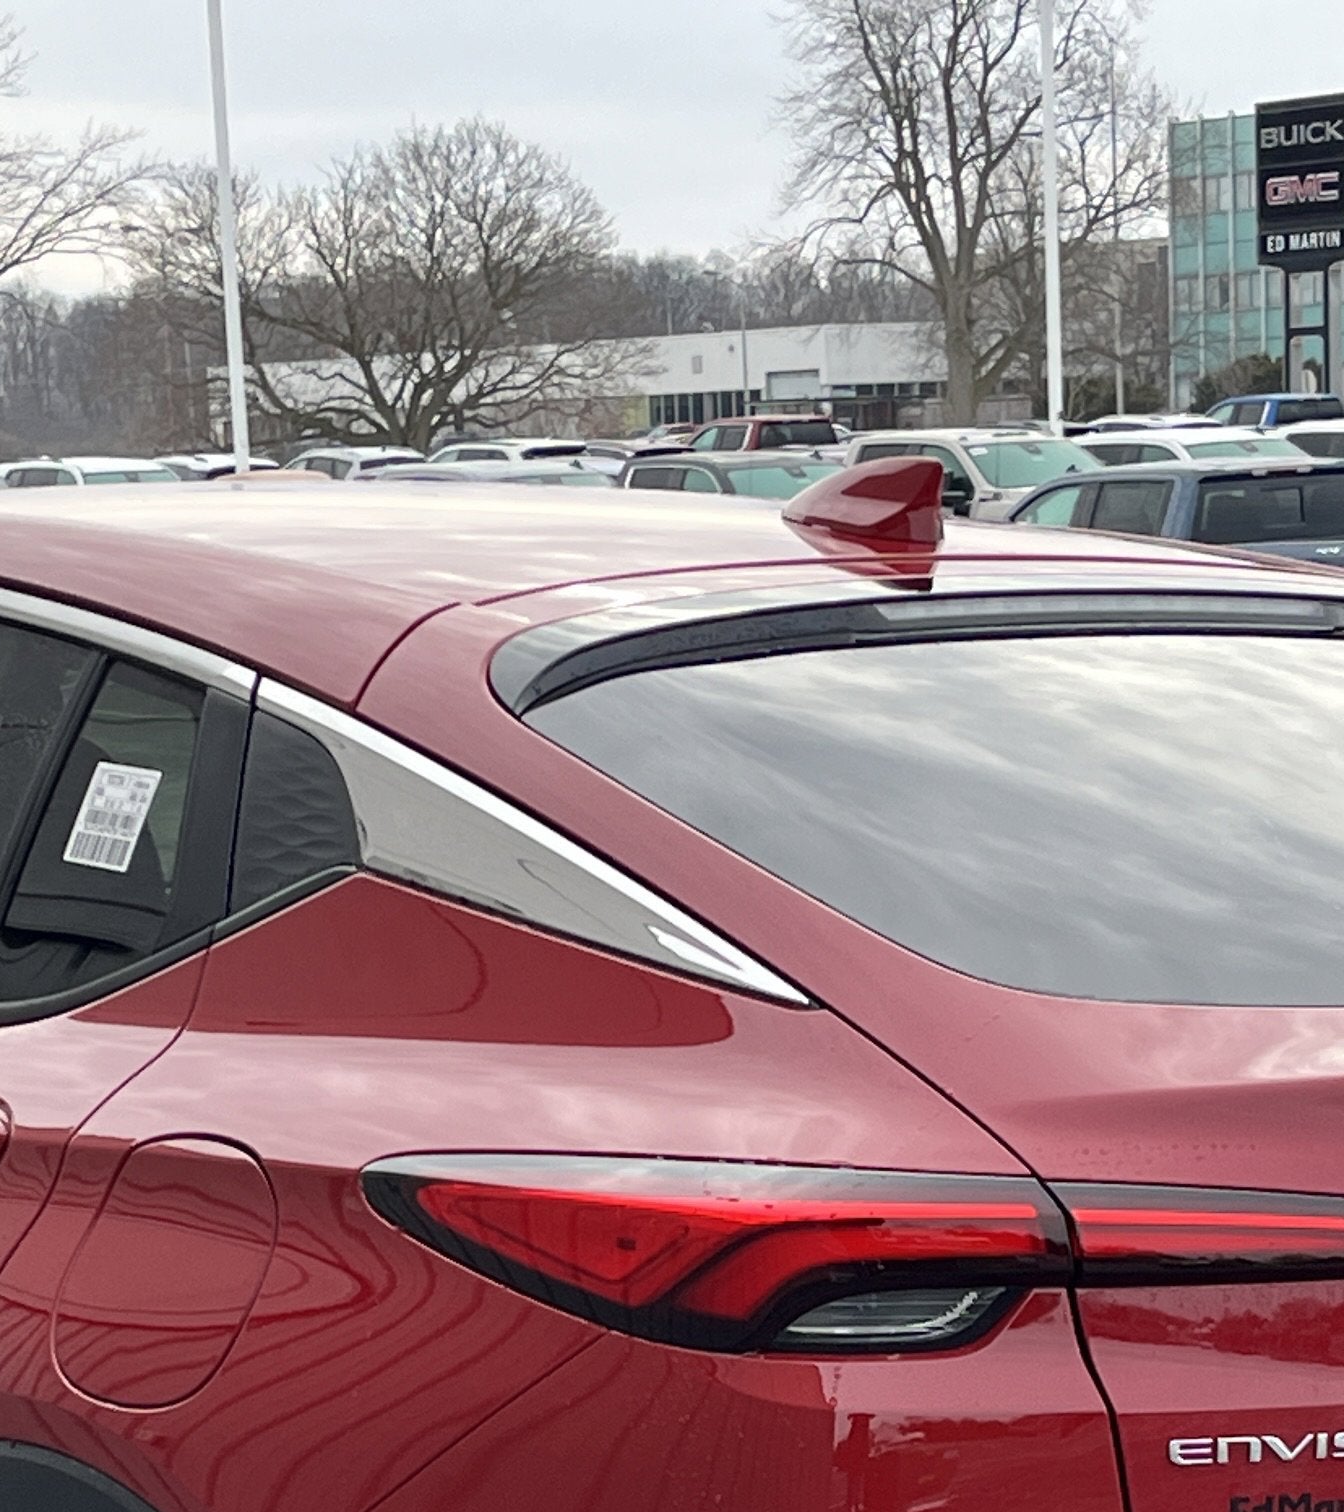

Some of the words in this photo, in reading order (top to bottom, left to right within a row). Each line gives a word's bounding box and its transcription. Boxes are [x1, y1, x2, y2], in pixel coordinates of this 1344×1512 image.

[1260, 119, 1344, 149] BUICK
[1267, 172, 1339, 205] GMC
[1267, 235, 1285, 252] ED
[1289, 230, 1341, 250] MARTIN
